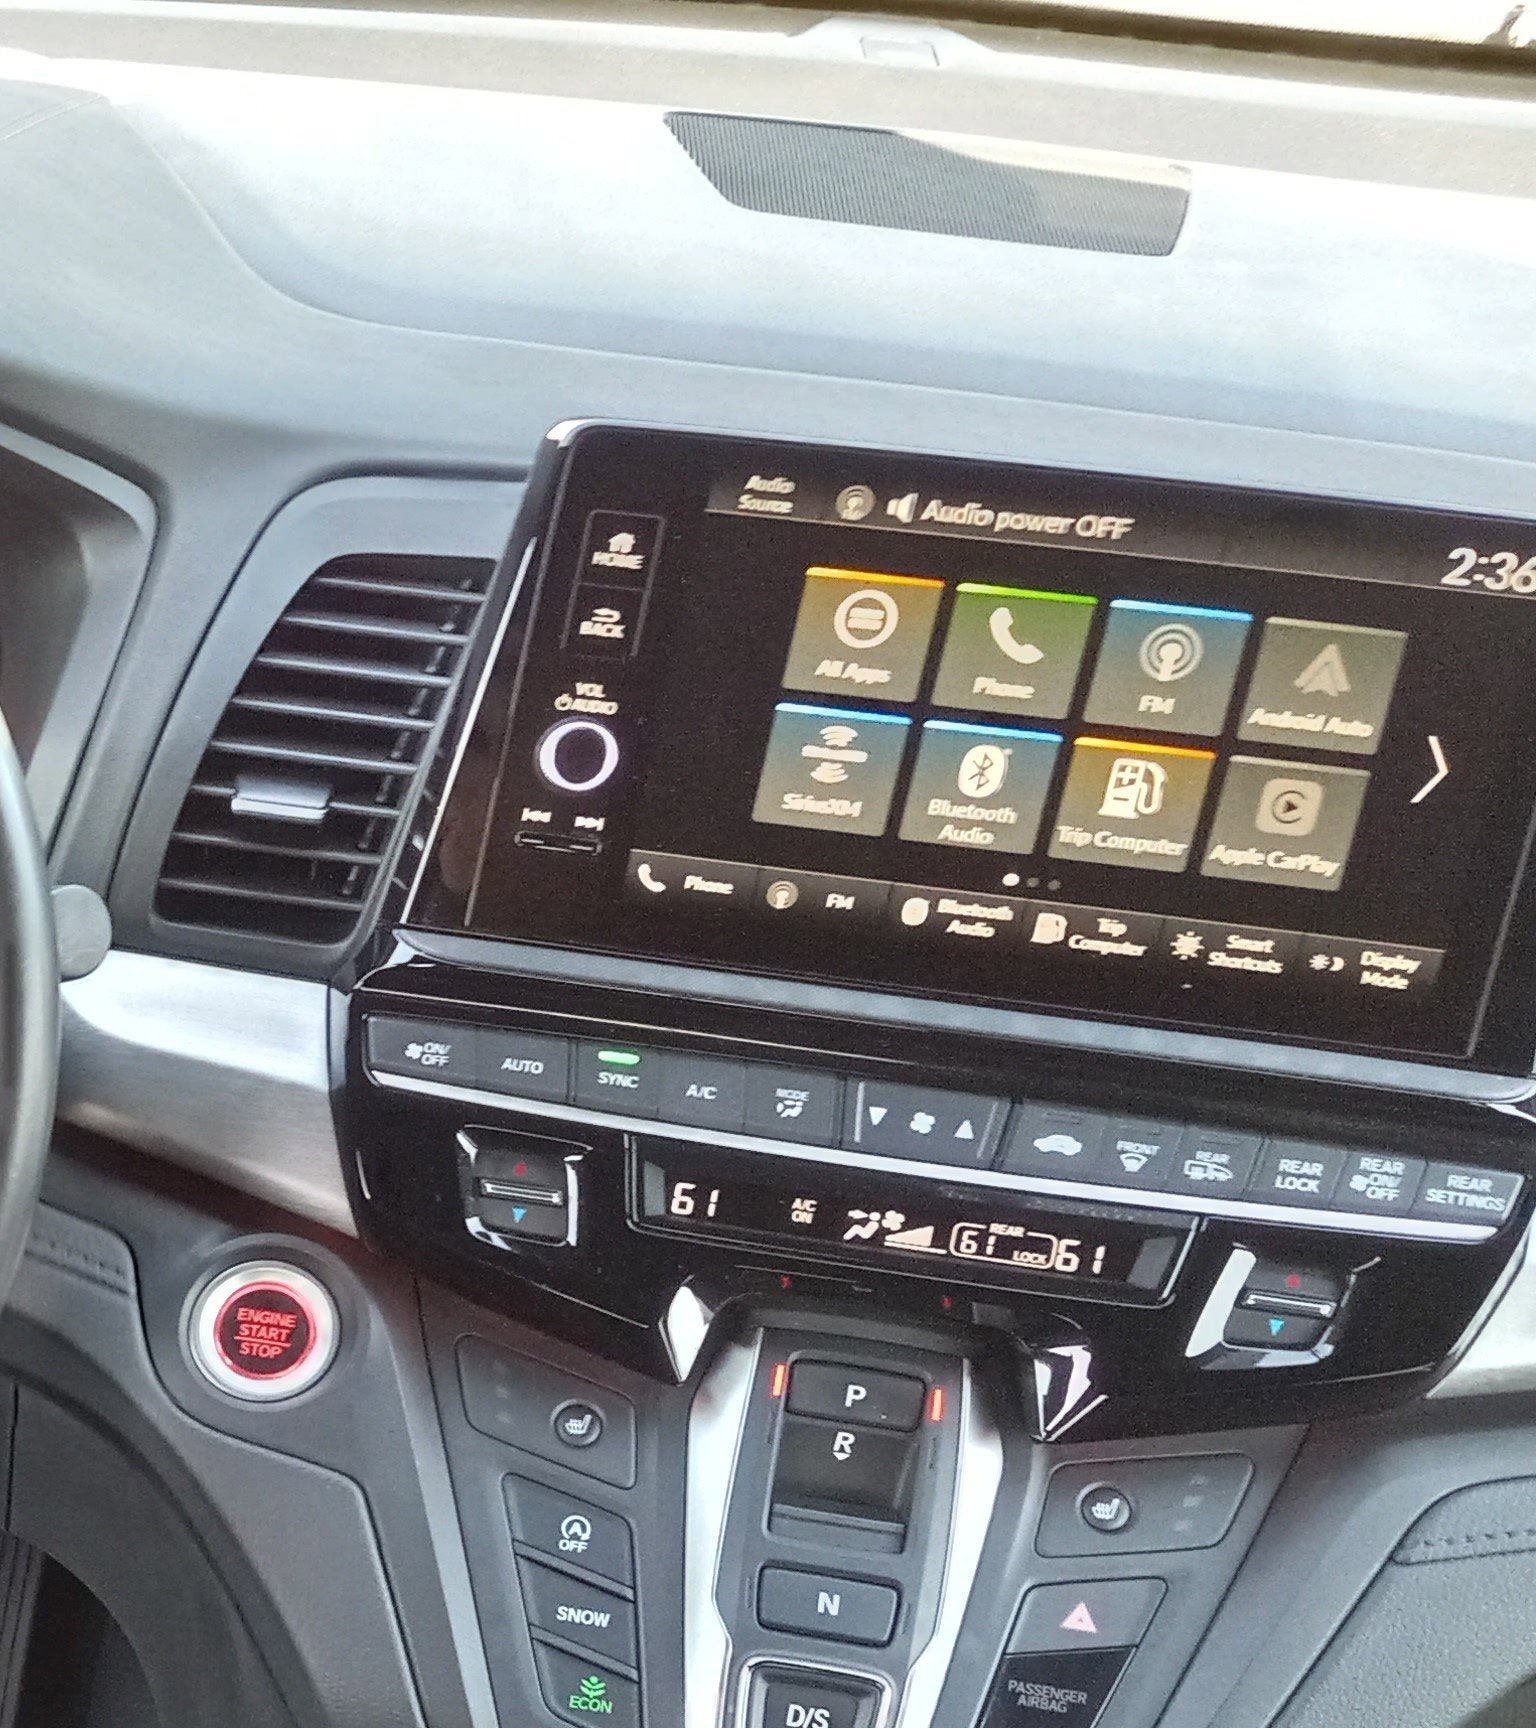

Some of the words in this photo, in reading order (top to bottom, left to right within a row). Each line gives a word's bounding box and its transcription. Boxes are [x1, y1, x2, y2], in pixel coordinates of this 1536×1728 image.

[744, 475, 796, 494] Audio
[738, 494, 794, 514] Source
[921, 499, 993, 528] Audio
[994, 511, 1075, 534] power
[1075, 515, 1135, 540] OFF
[1441, 547, 1536, 593] 2:36
[841, 663, 892, 684] Apps
[576, 682, 606, 698] VOL
[973, 677, 1035, 699] Phone
[1138, 695, 1176, 714] FM
[1247, 708, 1326, 732] Android
[1323, 716, 1374, 738] Auto
[927, 799, 1018, 823] Bluetooth
[938, 824, 995, 845] Audio
[1057, 825, 1093, 848] Trip
[1093, 831, 1188, 857] Computer
[1208, 845, 1266, 866] Apple
[1267, 851, 1340, 877] CarPlay
[684, 875, 734, 895] Phone
[826, 893, 855, 910] FM
[1226, 935, 1275, 953] Smart
[1360, 951, 1421, 974] Display
[1360, 971, 1410, 990] Mode
[421, 1055, 449, 1067] OFF
[501, 1058, 544, 1074] AUTO
[597, 1071, 640, 1088] SYNC
[685, 1084, 718, 1100] A/C
[775, 1088, 810, 1101] MODE
[1117, 1140, 1161, 1156] FRONT
[1196, 1151, 1230, 1164] REAR
[1278, 1158, 1324, 1177] REAR
[1359, 1156, 1406, 1175] REAR
[1275, 1175, 1321, 1194] LOCK
[1446, 1174, 1494, 1193] REAR
[670, 1182, 720, 1217] 61
[1366, 1187, 1400, 1201] OFF
[1425, 1188, 1506, 1212] SETTINGS
[791, 1198, 817, 1212] A/C
[791, 1211, 813, 1225] ON
[989, 1223, 1026, 1238] REAR
[959, 1230, 997, 1256] 61
[1012, 1250, 1048, 1265] LOCK
[1054, 1238, 1106, 1275] 61
[236, 1307, 298, 1328] ENGINE
[239, 1324, 291, 1341] START
[239, 1341, 283, 1359] STOP
[845, 1384, 867, 1408] P
[833, 1431, 855, 1454] R
[558, 1539, 588, 1553] OFF
[817, 1591, 841, 1616] N
[556, 1605, 610, 1628] SNOW
[1008, 1680, 1088, 1705] PASSENGER
[568, 1695, 613, 1714] ECON
[1017, 1694, 1068, 1713] AIRBAG
